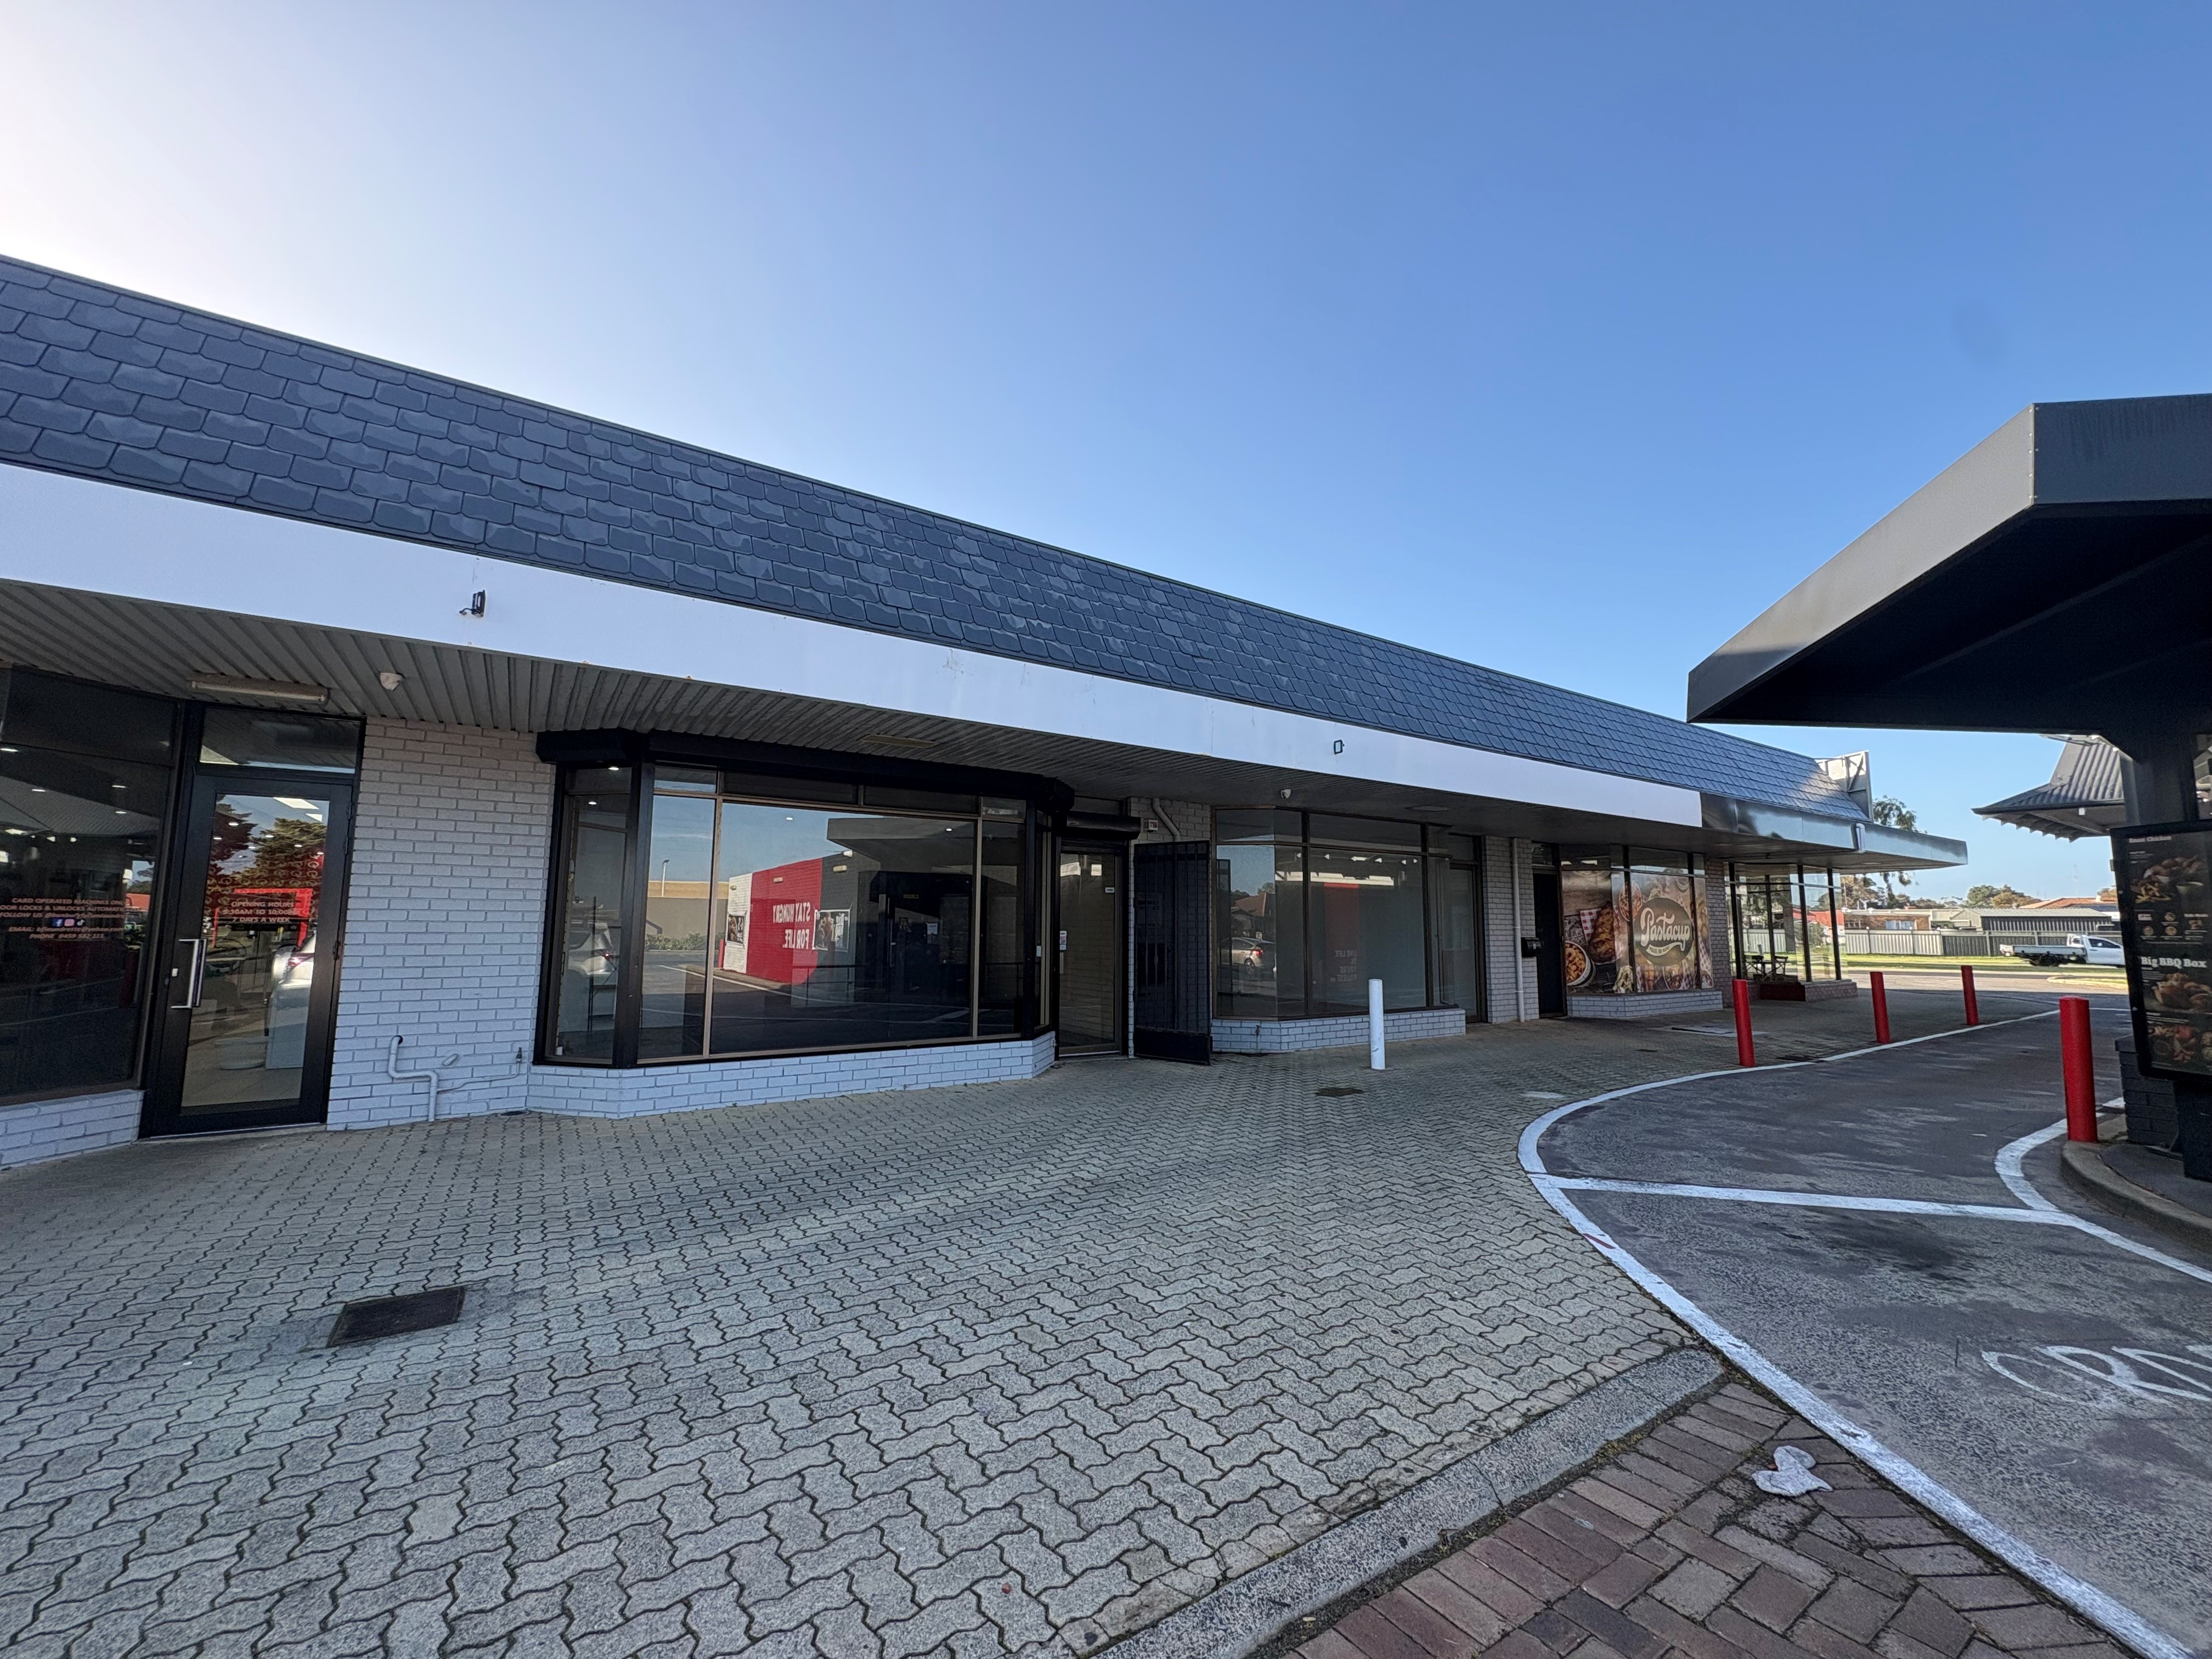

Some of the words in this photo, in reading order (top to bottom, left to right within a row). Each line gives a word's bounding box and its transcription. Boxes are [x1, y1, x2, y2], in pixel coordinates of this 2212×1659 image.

[1640, 907, 1690, 951] Pastacup
[2141, 956, 2159, 968] Big
[2159, 958, 2182, 969] BBQ
[2183, 958, 2208, 968] Box
